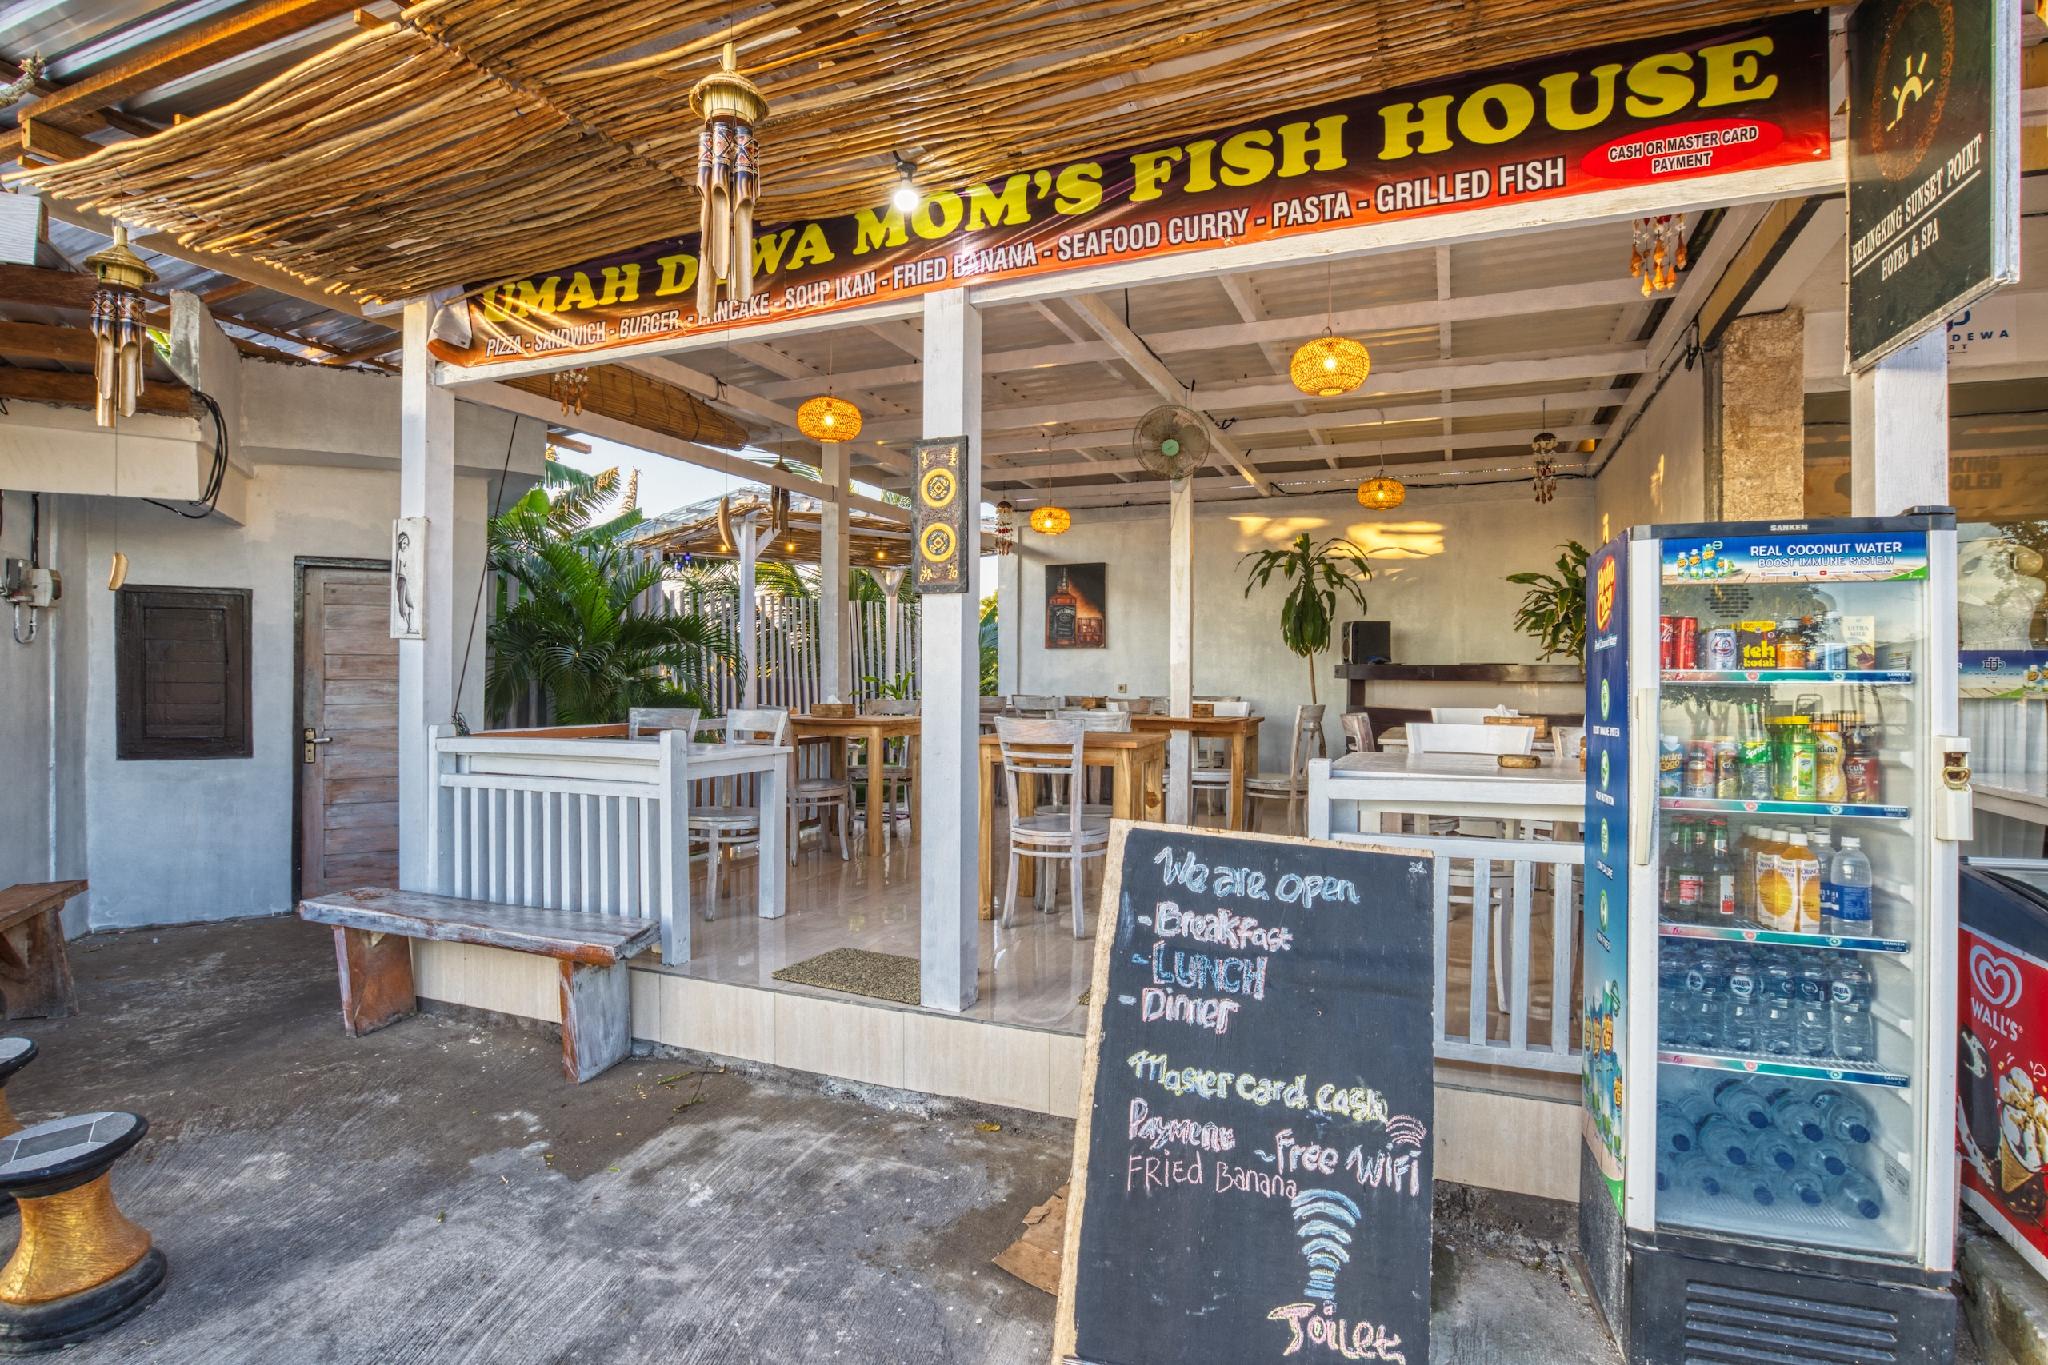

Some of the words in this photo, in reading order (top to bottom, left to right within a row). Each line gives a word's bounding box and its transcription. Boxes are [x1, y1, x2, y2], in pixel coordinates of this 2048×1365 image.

[1608, 143, 1643, 162] CASH
[1646, 141, 1664, 156] OR
[1667, 132, 1719, 152] MASTER
[1722, 125, 1759, 144] CARD
[1652, 151, 1712, 174] PAYMENT
[481, 263, 641, 322] UMAH
[655, 222, 836, 297] DWA
[853, 161, 1103, 256] MOM'S
[1129, 114, 1348, 202] FISH
[1377, 36, 1779, 160] HOUSE
[1852, 205, 1902, 268] KELINGKING
[1905, 167, 1943, 222] SUNSET
[1946, 133, 1981, 188] POINT
[486, 335, 522, 357] PIZZA
[534, 321, 606, 351] SANDWICH
[619, 310, 680, 338] BURGER
[785, 280, 830, 311] SOUP
[836, 271, 876, 301] IKAN
[892, 257, 947, 291] FRIED
[953, 243, 1038, 278] BANANA
[1057, 221, 1161, 262] SEAFOOD
[1167, 207, 1249, 246] CURRY
[1272, 191, 1351, 229] PASTA
[1375, 168, 1491, 213] GRILLED
[1499, 155, 1567, 196] FISH
[1881, 242, 1909, 281] HOTEL
[1921, 218, 1939, 250] SPA
[1952, 330, 2009, 342] DEWA
[1750, 545, 1783, 557] REAL
[1786, 543, 1851, 556] COCONUT
[1855, 541, 1902, 553] WATER
[1758, 557, 1795, 568] BOOST
[1799, 556, 1845, 567] IMMUNE
[1850, 555, 1894, 566] SYSTEM
[1743, 640, 1776, 658] teh
[1743, 658, 1776, 668] kotak
[1154, 846, 1209, 893] We
[1213, 866, 1269, 900] are
[1275, 872, 1361, 908] open
[1153, 939, 1269, 1000] LUNCH
[1141, 987, 1241, 1035] Dinner
[1970, 996, 2018, 1041] WALL'S
[1275, 1128, 1338, 1175] Free
[1216, 1161, 1297, 1200] Banana
